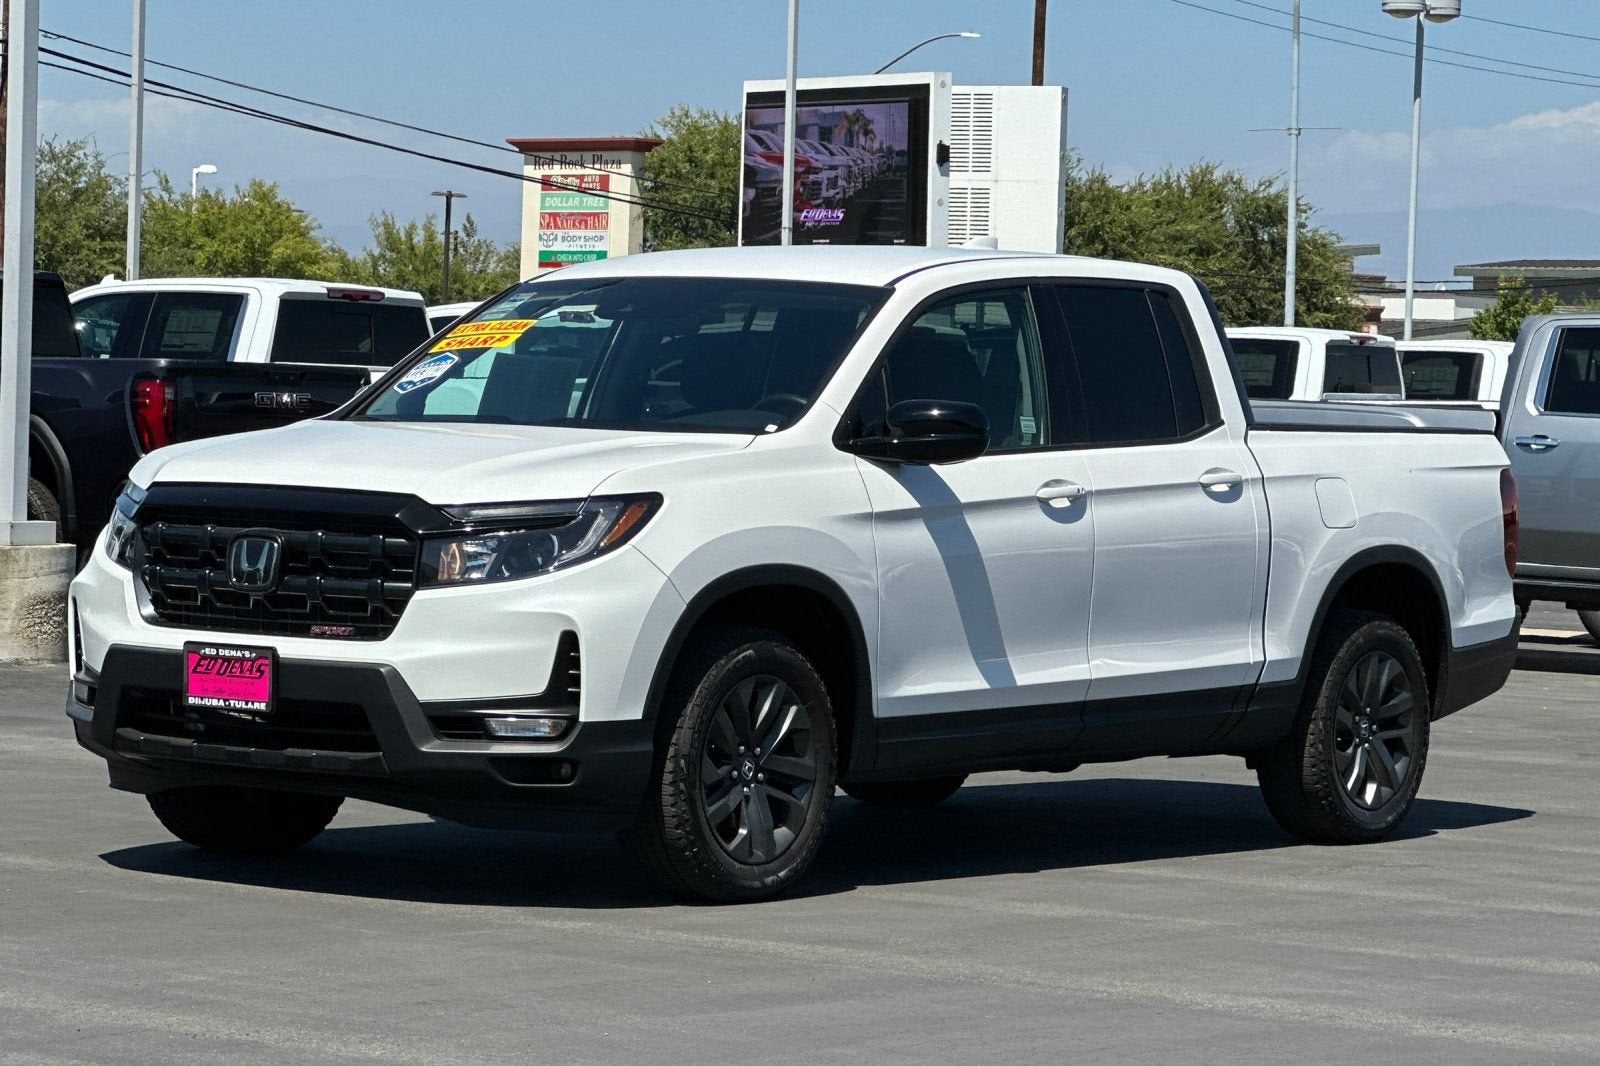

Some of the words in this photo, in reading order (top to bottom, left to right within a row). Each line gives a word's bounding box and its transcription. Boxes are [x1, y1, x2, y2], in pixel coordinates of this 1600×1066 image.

[533, 155, 554, 171] Red
[559, 153, 586, 170] Rock
[591, 153, 622, 170] Plaza
[583, 175, 600, 183] AUTO
[581, 182, 601, 190] PARTS
[545, 197, 580, 207] DOLLAR
[583, 196, 605, 207] TREE
[540, 213, 555, 230] SPA
[556, 216, 580, 230] NAILS
[587, 213, 609, 230] HAIR
[561, 235, 583, 243] BODY
[583, 235, 605, 243] SHOP
[451, 325, 489, 336] EXTRA
[490, 321, 531, 332] CLEAN
[439, 335, 511, 350] SHARP
[205, 647, 217, 655] ED
[218, 648, 251, 658] DENA'S
[229, 699, 267, 710] TULARE
